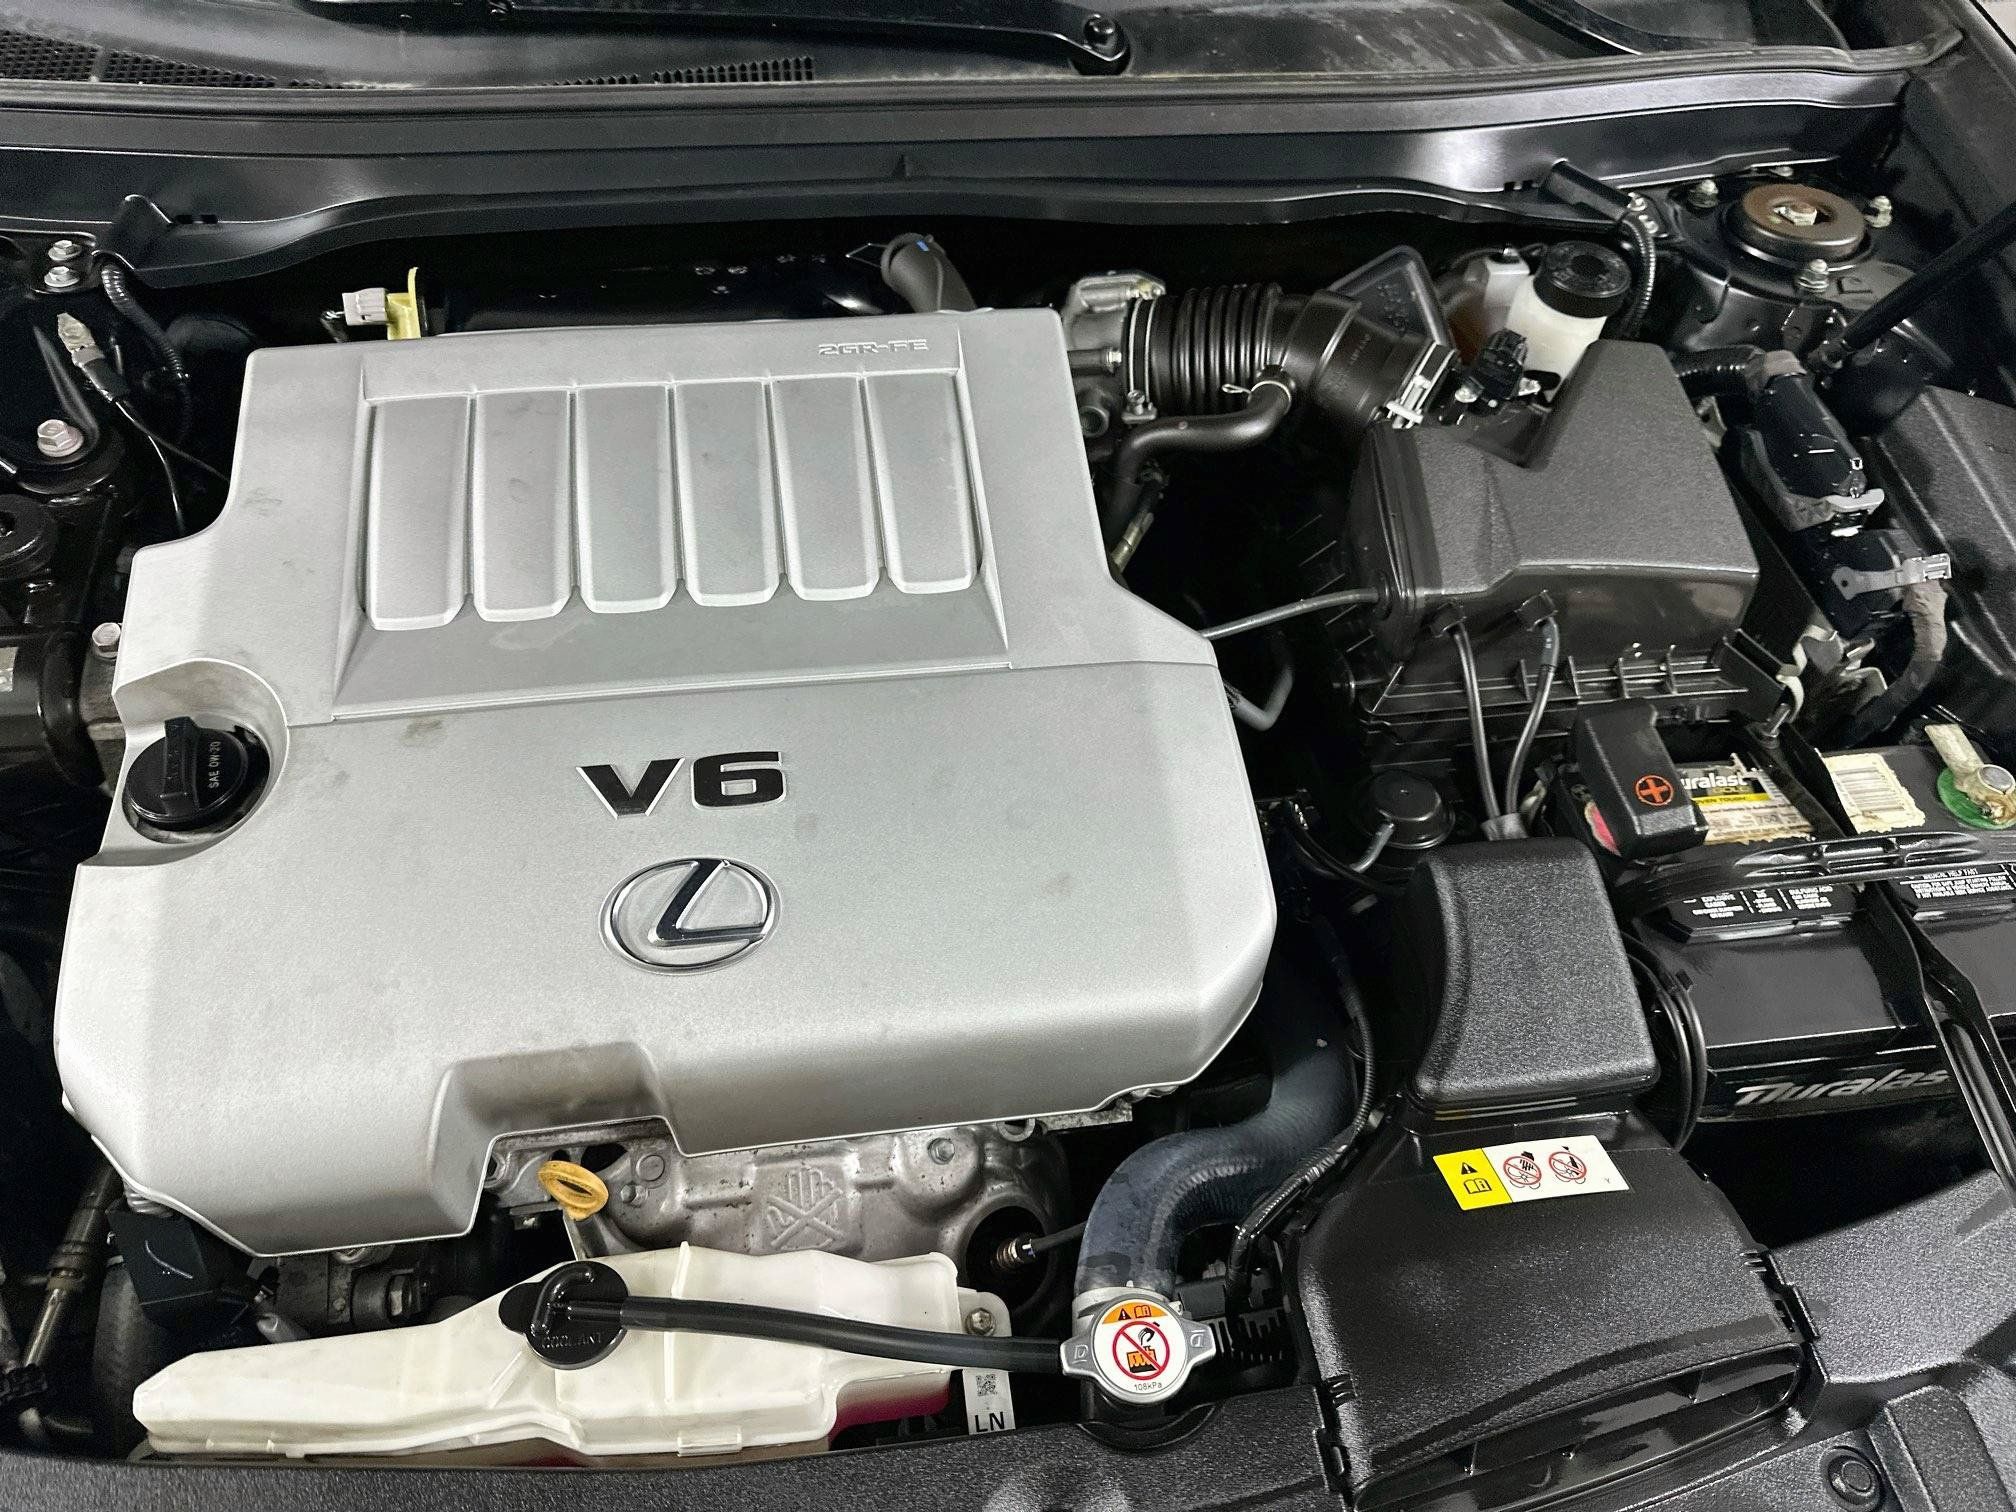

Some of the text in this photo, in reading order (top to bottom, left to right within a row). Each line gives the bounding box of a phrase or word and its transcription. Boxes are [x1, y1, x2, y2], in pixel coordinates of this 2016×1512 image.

[818, 338, 929, 355] 2GR-FE
[208, 770, 220, 789] SAE
[575, 751, 787, 820] V6
[1681, 772, 1748, 790] uralast
[1735, 1068, 1950, 1106] Duralas
[1133, 1382, 1163, 1391] 108kPa
[974, 1411, 1005, 1432] LN
